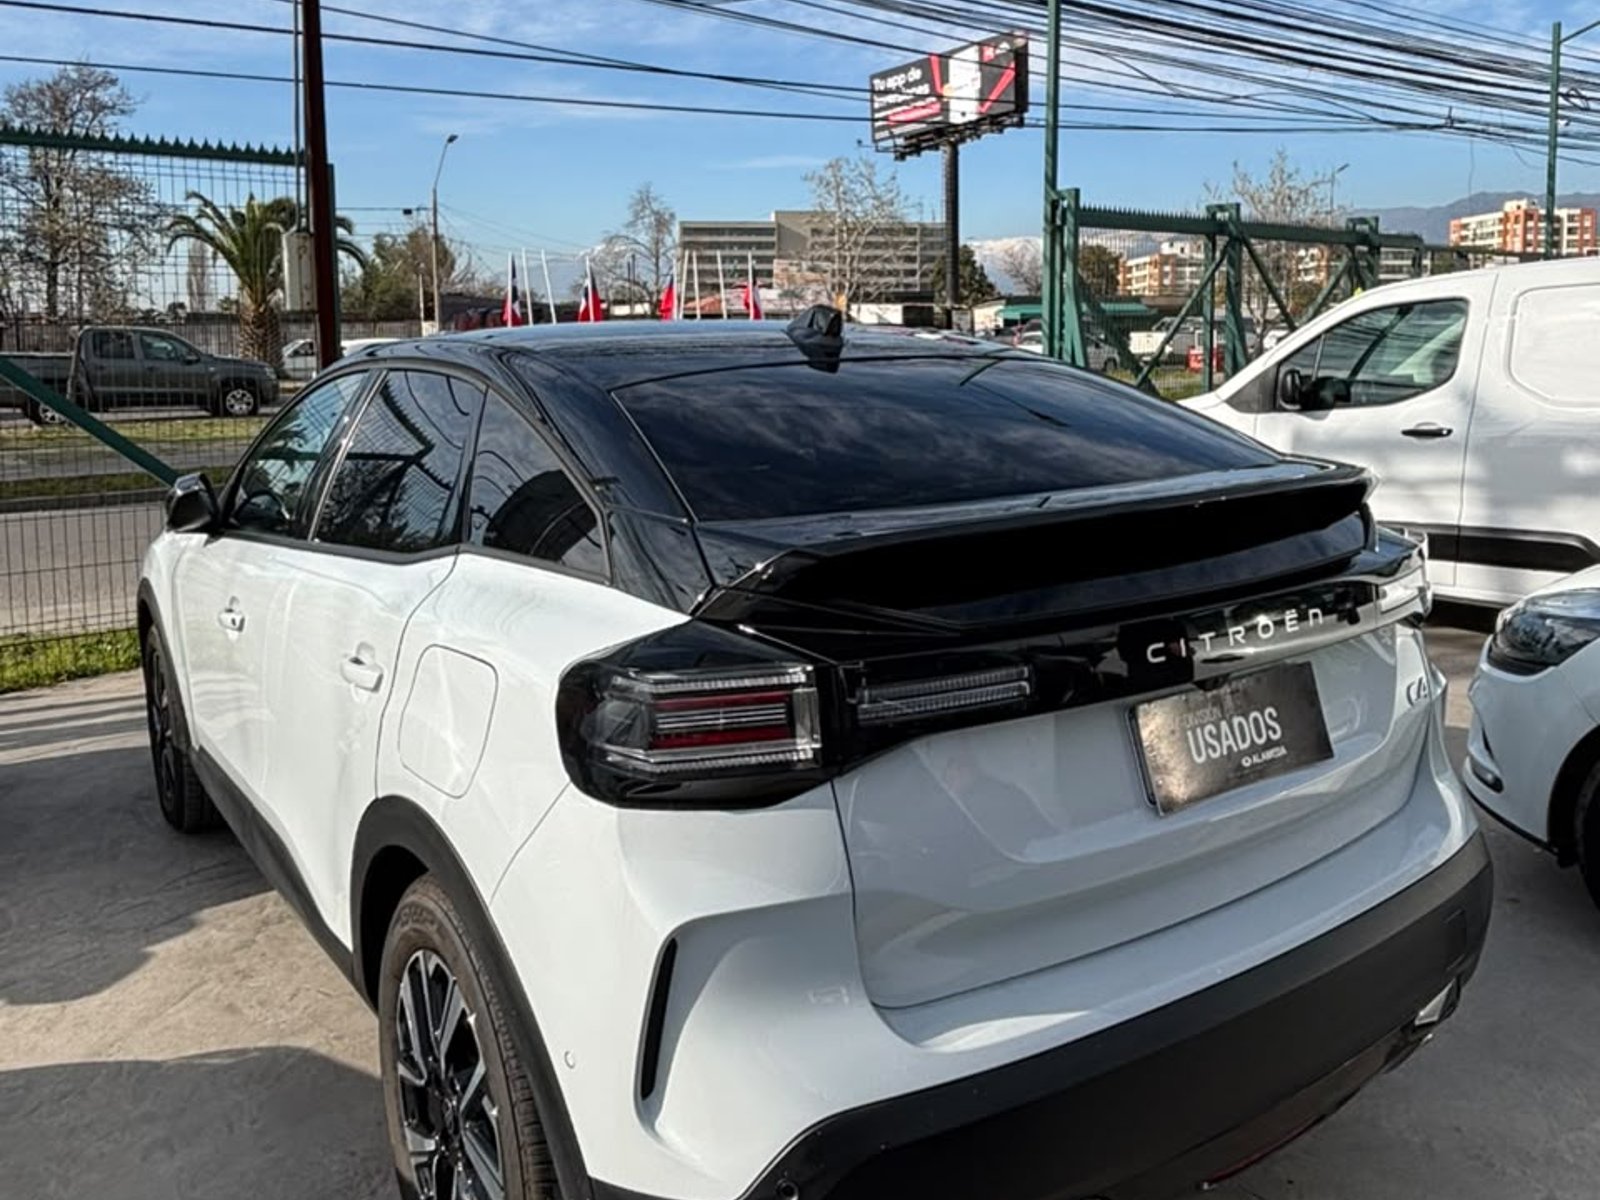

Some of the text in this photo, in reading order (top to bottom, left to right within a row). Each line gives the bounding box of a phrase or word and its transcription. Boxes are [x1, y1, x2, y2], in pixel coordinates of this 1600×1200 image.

[873, 67, 922, 91] Tu app de
[1186, 706, 1282, 763] USADOS
